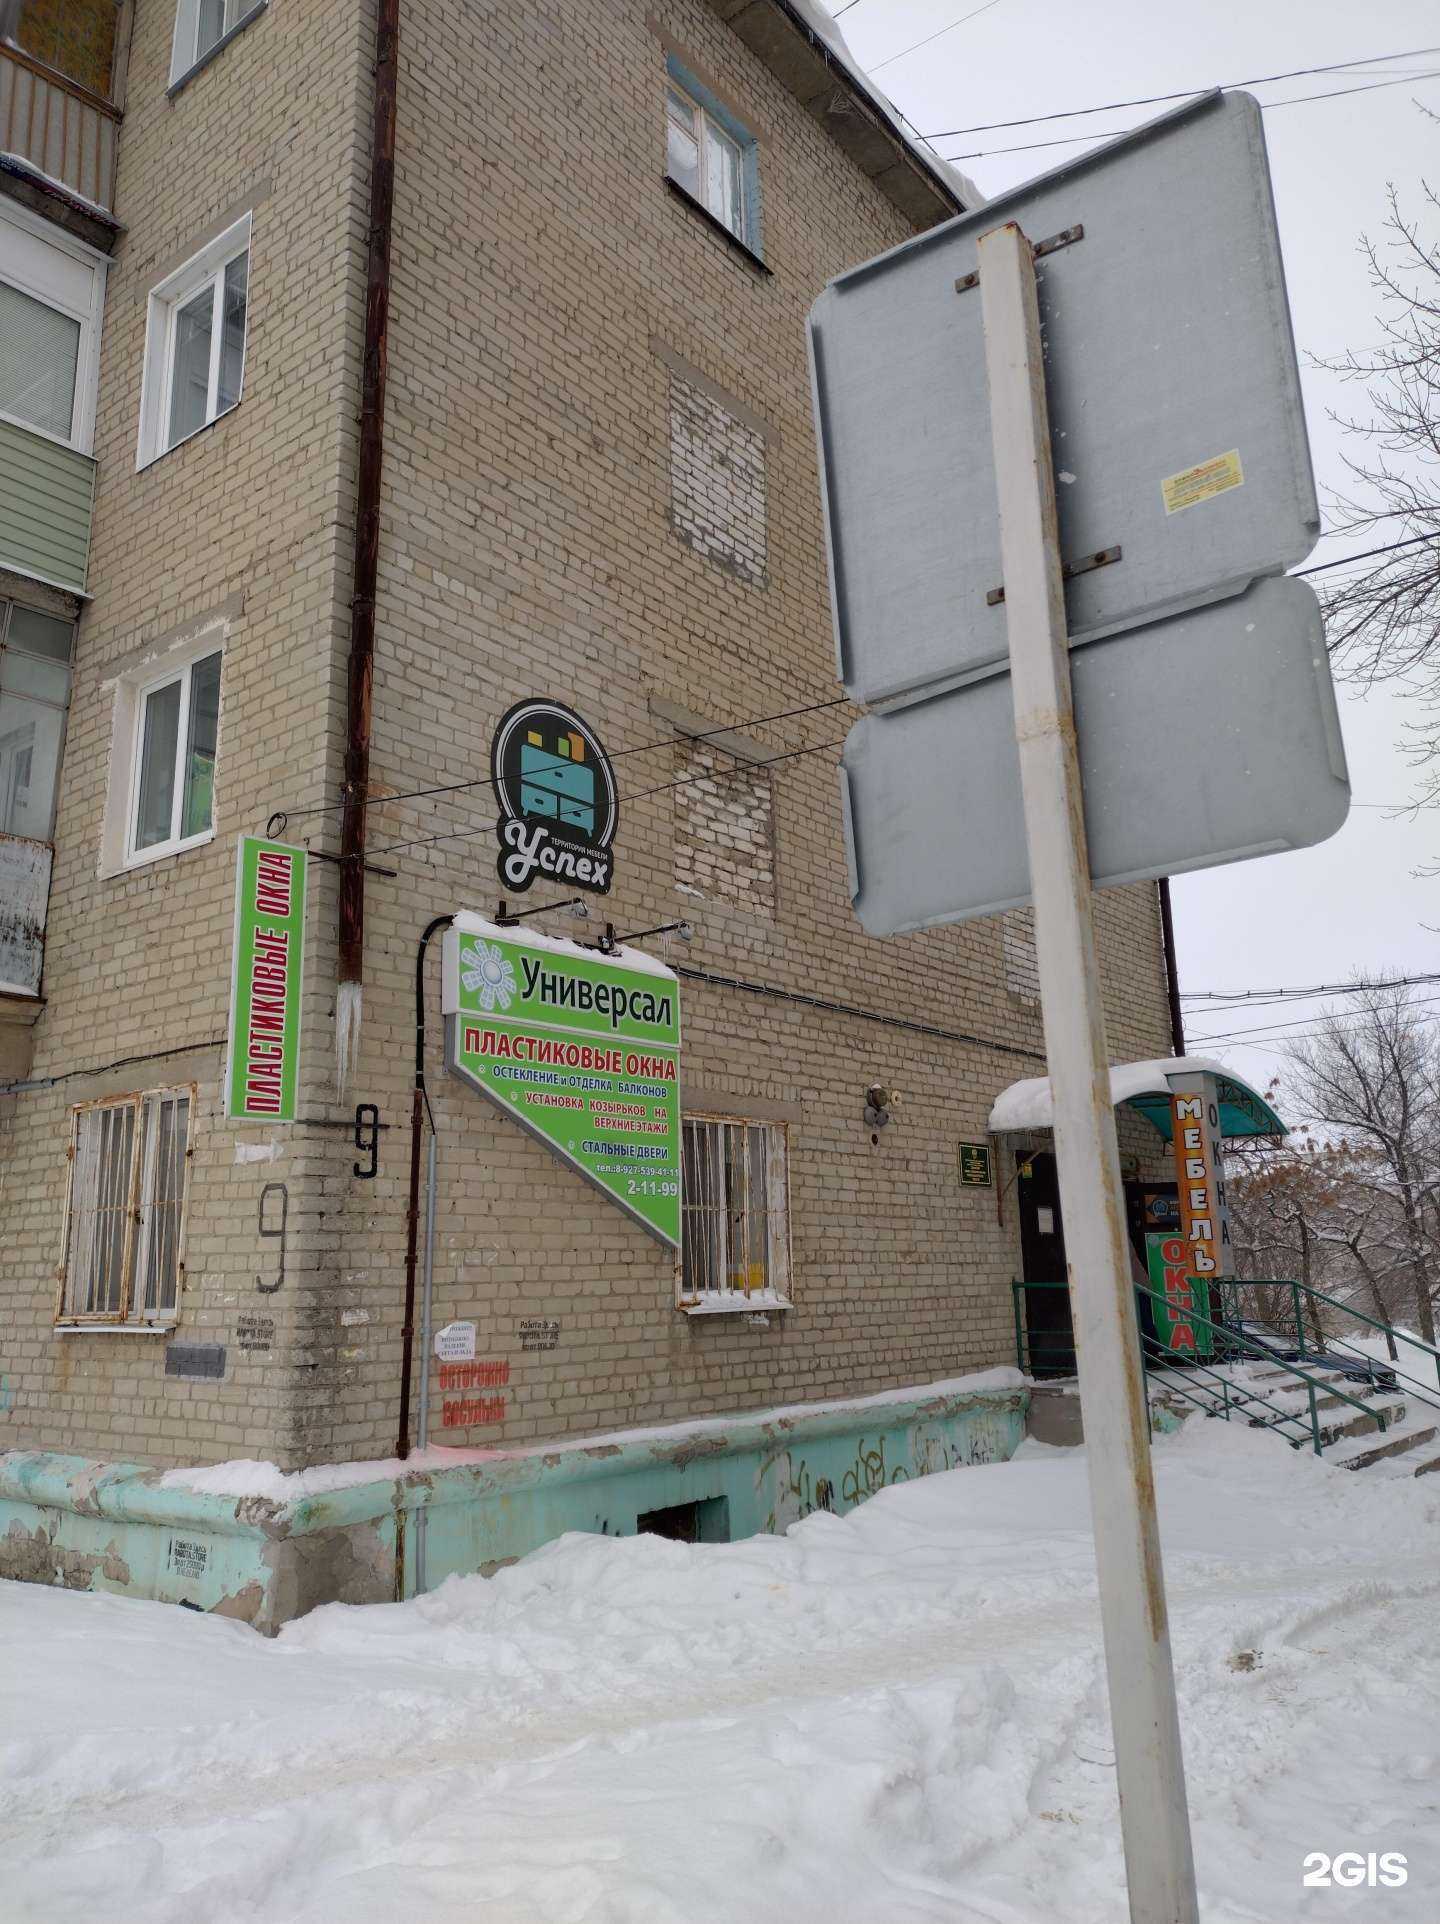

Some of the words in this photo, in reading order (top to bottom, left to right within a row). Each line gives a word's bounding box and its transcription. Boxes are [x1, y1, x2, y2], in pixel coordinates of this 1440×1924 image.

[504, 819, 608, 887] Успех
[551, 837, 586, 854] ТЕРРИТОРИЯ
[586, 848, 608, 860] МЕБЕЛИ
[256, 850, 292, 918] ОКНА
[245, 925, 289, 1114] ПЛАСТИКОВЫЕ
[520, 956, 671, 1027] Универсал
[464, 1028, 622, 1074] ПЛАСТИКОВЫЕ
[626, 1053, 677, 1081] ОКНА
[493, 1065, 559, 1086] ОСТЕКЛЕНИЕ
[569, 1076, 612, 1093] ОТДЕЛКА
[618, 1082, 667, 1099] БАЛКОНОВ
[526, 1092, 584, 1110] УСТАНОВКА
[589, 1100, 646, 1117] КОЗЫРЬКОВ
[654, 1107, 667, 1119] НА
[353, 1103, 379, 1179] 9
[582, 1141, 635, 1157] СТАЛЬНЫЕ
[636, 1147, 668, 1160] ДВЕРИ
[1208, 1103, 1231, 1245] ОКНА
[627, 1180, 678, 1196] 2-11-99
[1176, 1098, 1215, 1273] МЕБЕЛЬ
[256, 1183, 288, 1293] 9
[1162, 1239, 1196, 1351] ОКНА
[439, 1361, 510, 1390] ОСТОРОЖНО
